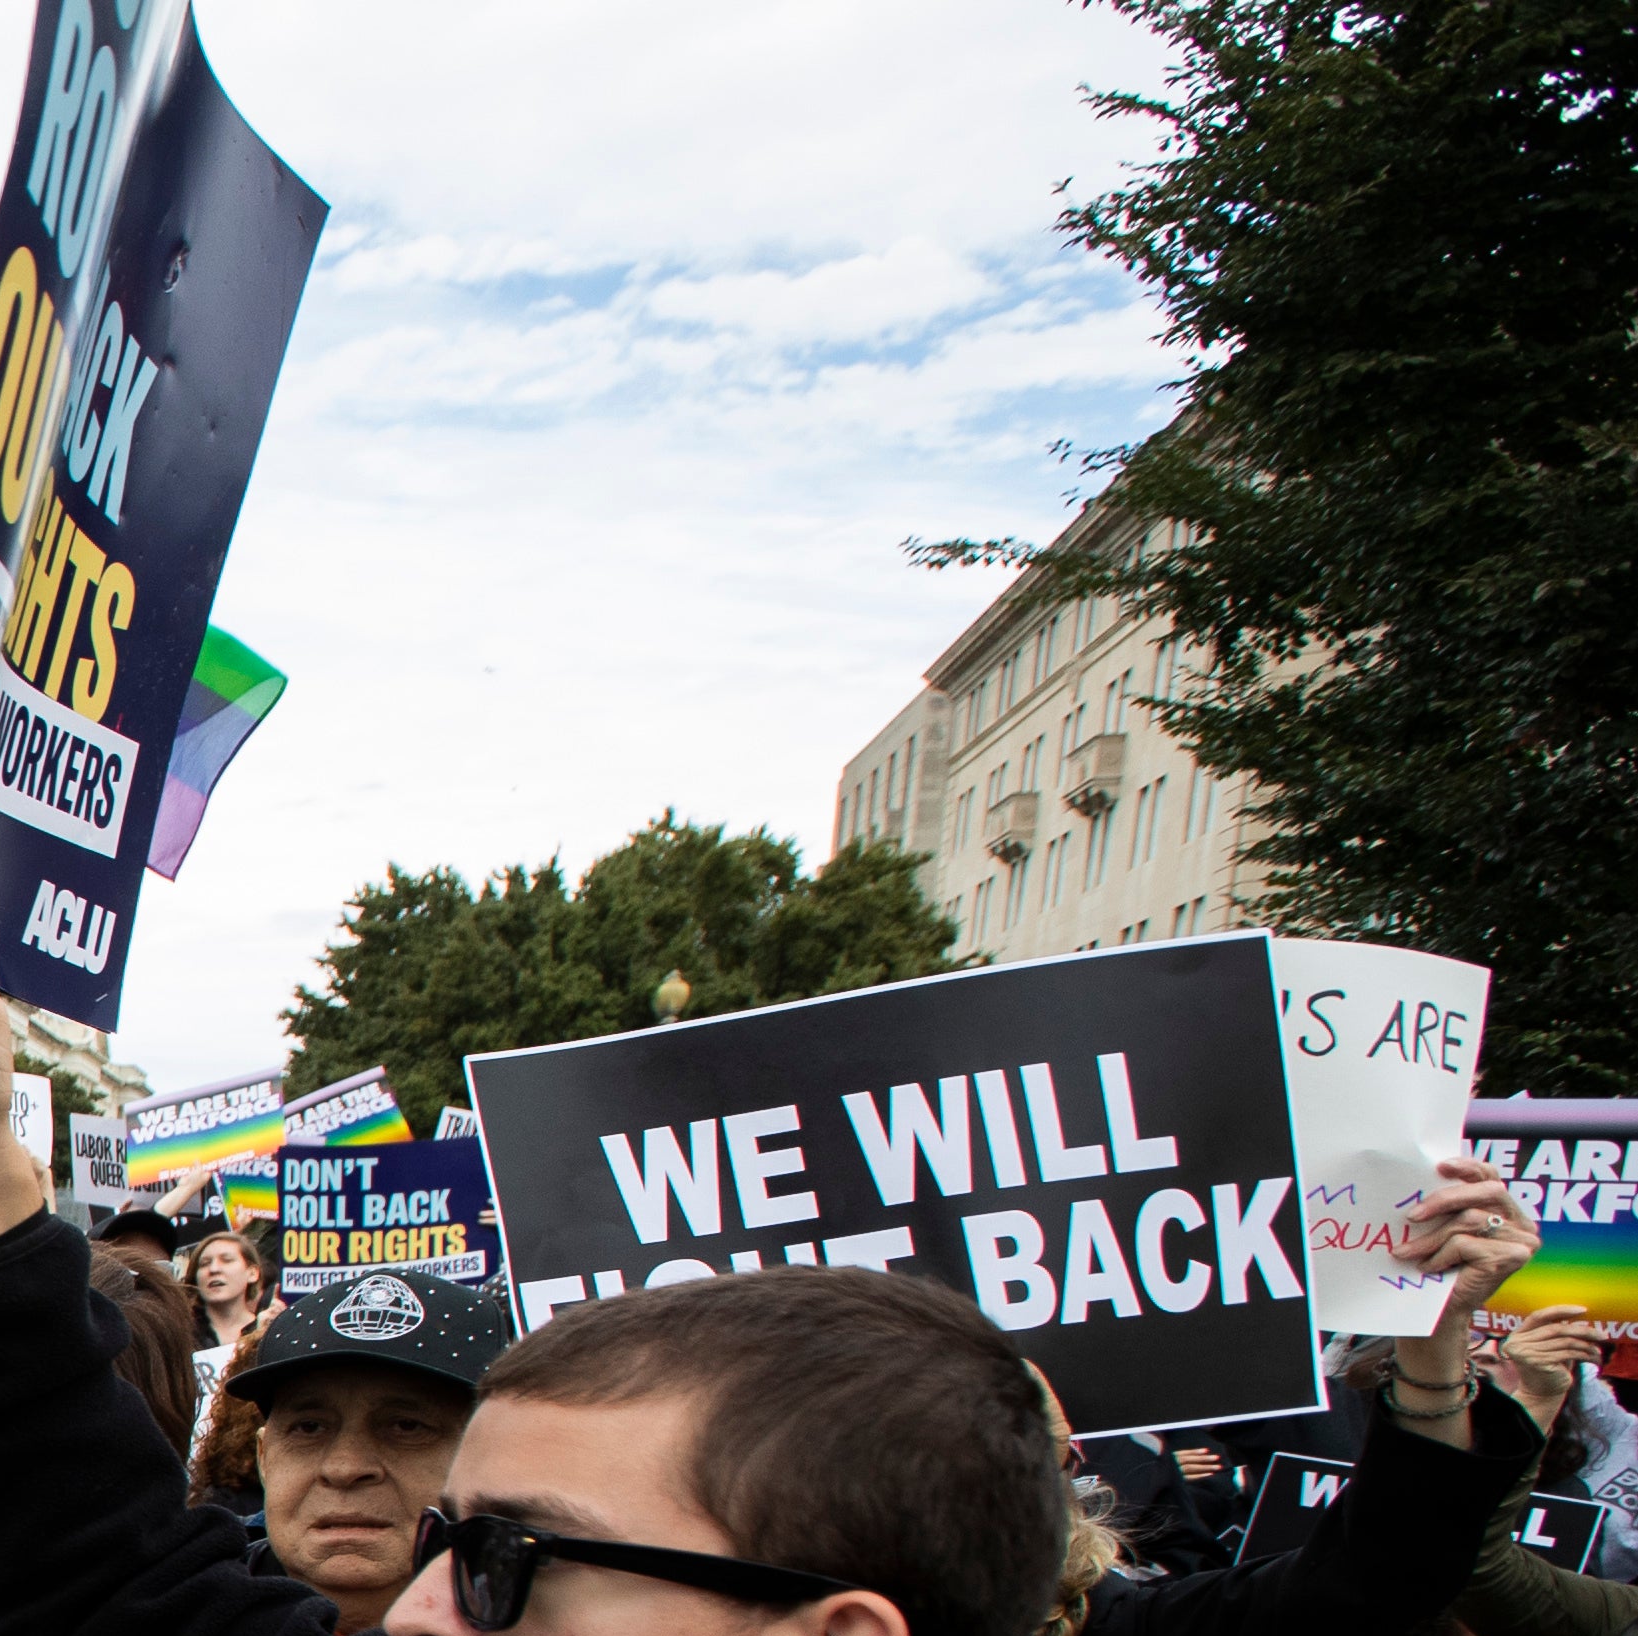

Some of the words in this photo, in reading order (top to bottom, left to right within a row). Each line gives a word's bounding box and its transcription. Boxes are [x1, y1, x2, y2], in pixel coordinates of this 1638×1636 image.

[22, 879, 116, 974] ACLU
[1366, 1000, 1468, 1074] ARE
[131, 1093, 281, 1145] WORKFORCE
[137, 1105, 176, 1127] WE
[178, 1092, 226, 1120] ARE
[227, 1080, 272, 1104] THE
[306, 1097, 347, 1124] ARE
[346, 1082, 382, 1107] THE
[76, 1132, 113, 1161] LABOR
[600, 1104, 819, 1245] WE
[842, 1052, 1179, 1206] WILL
[90, 1160, 125, 1189] QUEER
[284, 1194, 354, 1228] ROLL
[363, 1189, 451, 1228] BACK
[283, 1229, 341, 1264] OUR
[348, 1223, 467, 1263] RIGHTS
[962, 1177, 1305, 1332] BACK
